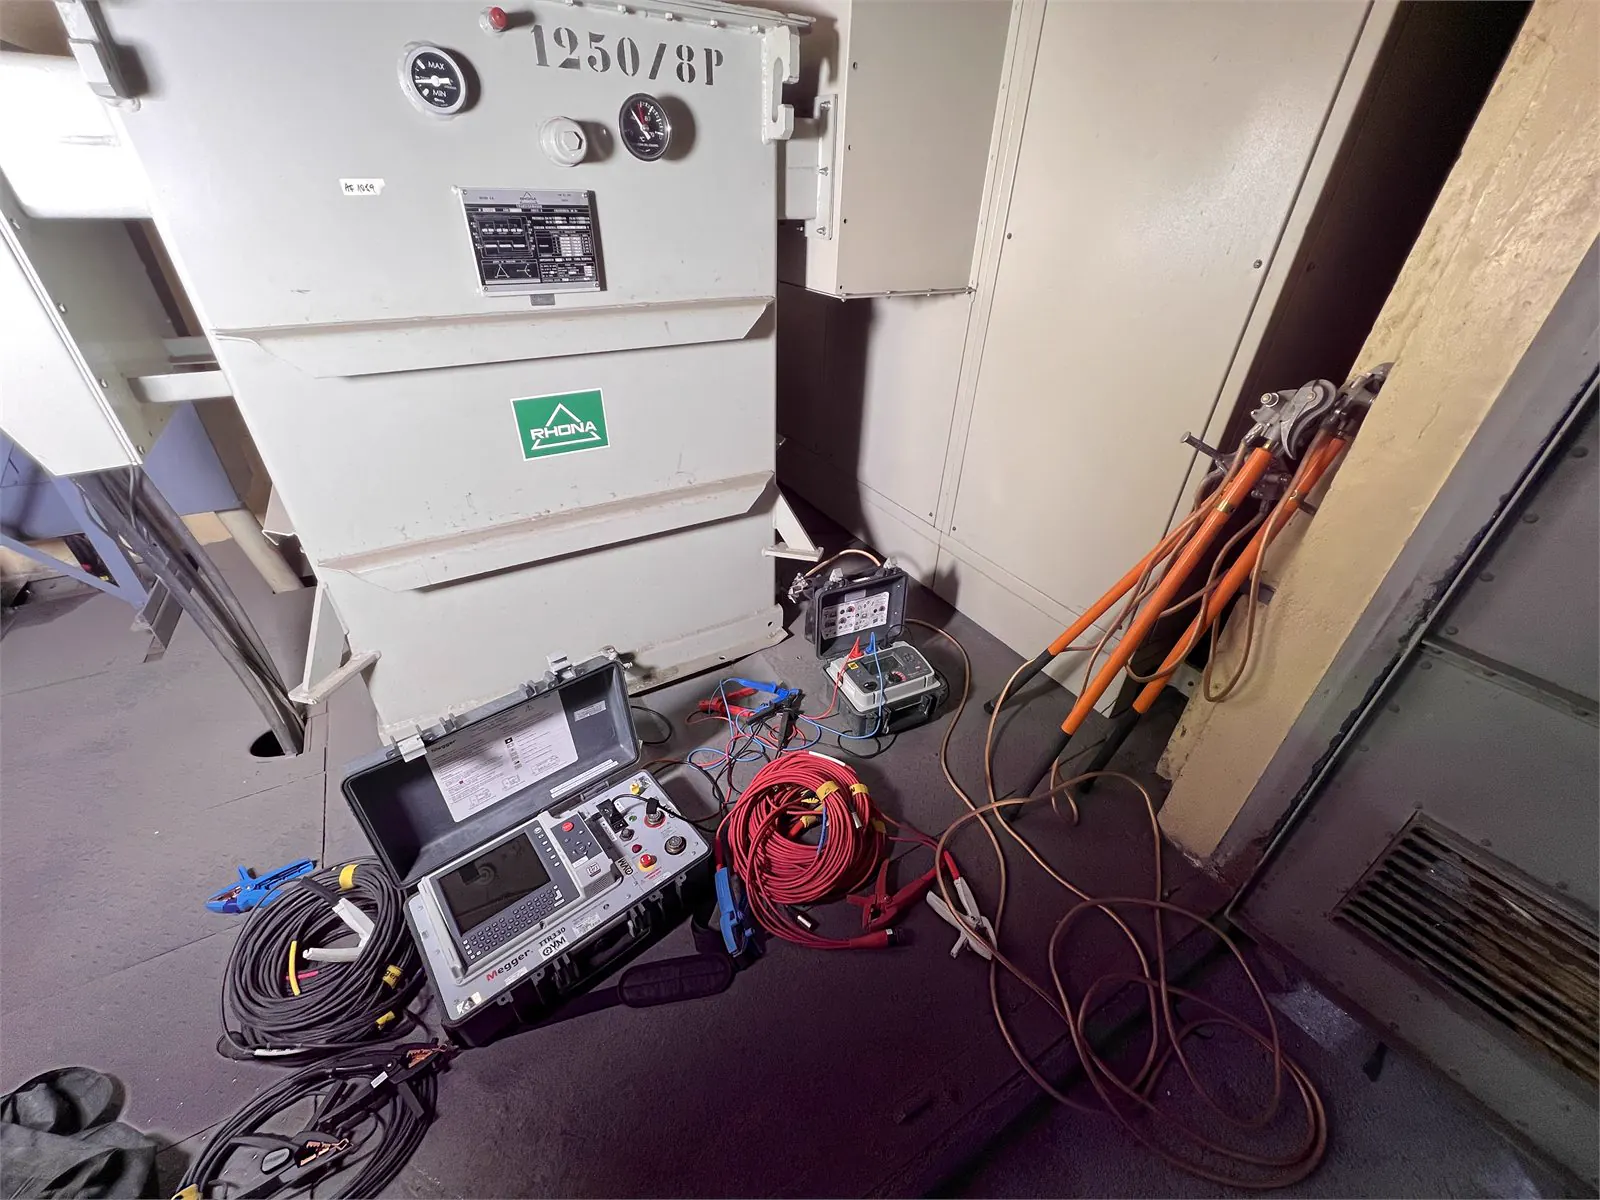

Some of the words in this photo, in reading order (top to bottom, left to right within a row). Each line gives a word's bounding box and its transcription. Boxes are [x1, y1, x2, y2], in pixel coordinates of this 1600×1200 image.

[530, 24, 724, 86] 1250/8P
[428, 61, 445, 70] MAX
[432, 89, 447, 97] MIN
[530, 421, 598, 441] RHONA
[538, 926, 566, 946] TTR330
[486, 949, 530, 981] Megger
